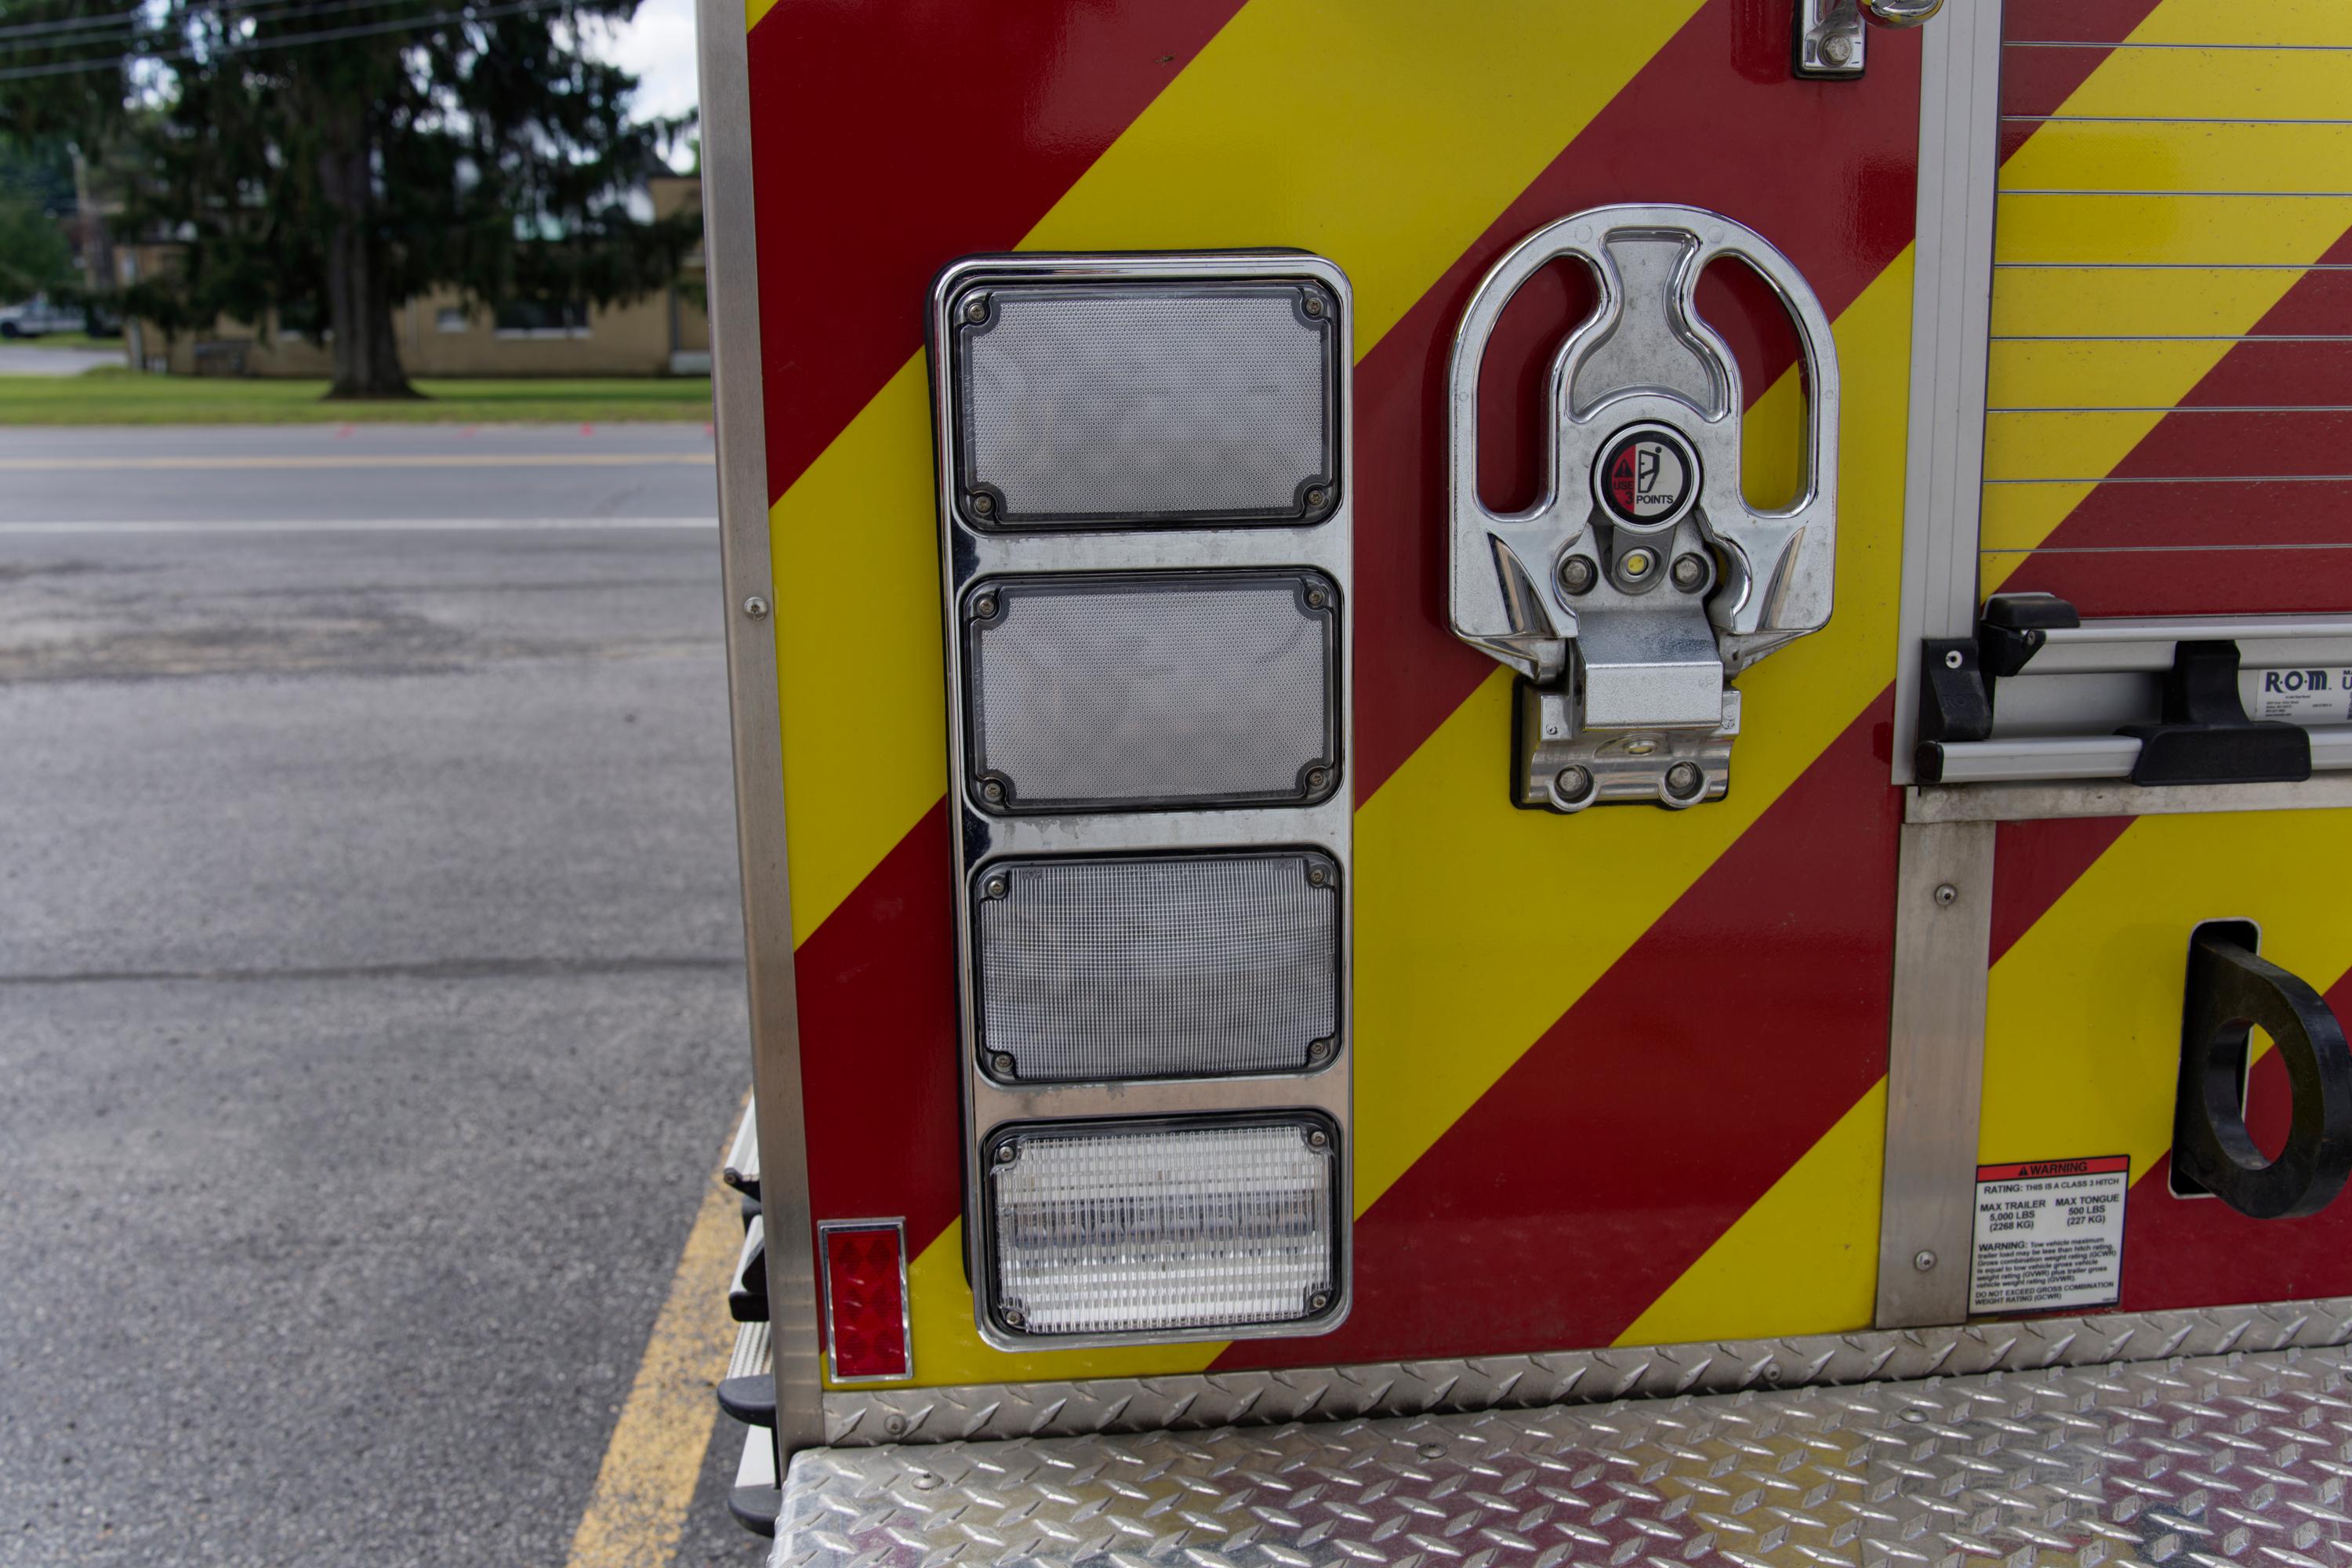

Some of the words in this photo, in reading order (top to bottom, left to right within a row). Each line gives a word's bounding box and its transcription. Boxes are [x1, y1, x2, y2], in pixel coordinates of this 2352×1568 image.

[1613, 481, 1634, 490] USE
[1625, 492, 1633, 504] 3
[1636, 495, 1673, 504] POINTS
[2030, 1162, 2088, 1175] WARNING
[1984, 1185, 2023, 1195] RATING:
[2026, 1183, 2043, 1192] THIS
[2061, 1180, 2087, 1189] CLASS
[2096, 1178, 2119, 1186] HITCH
[2056, 1197, 2077, 1206] MAX
[2081, 1194, 2120, 1204] TONGUE
[1980, 1203, 2002, 1212] MAX
[2005, 1200, 2045, 1210] TRAILER
[2069, 1207, 2084, 1215] 500
[2086, 1205, 2105, 1214] LBS
[1990, 1212, 2013, 1221] 5,000
[2016, 1210, 2034, 1219] LBS
[2067, 1217, 2085, 1227] (227
[2088, 1214, 2105, 1225] KG)
[1990, 1221, 2014, 1232] (2268
[2016, 1220, 2034, 1230] KG)
[1978, 1241, 2027, 1251] WARNING:
[2000, 1256, 2043, 1265] combination
[1976, 1274, 1998, 1283] weight
[2027, 1277, 2045, 1286] rating
[2064, 1281, 2114, 1291] COMBINATION
[2005, 1294, 2032, 1303] RATING
[2034, 1294, 2062, 1302] (GCWR)
